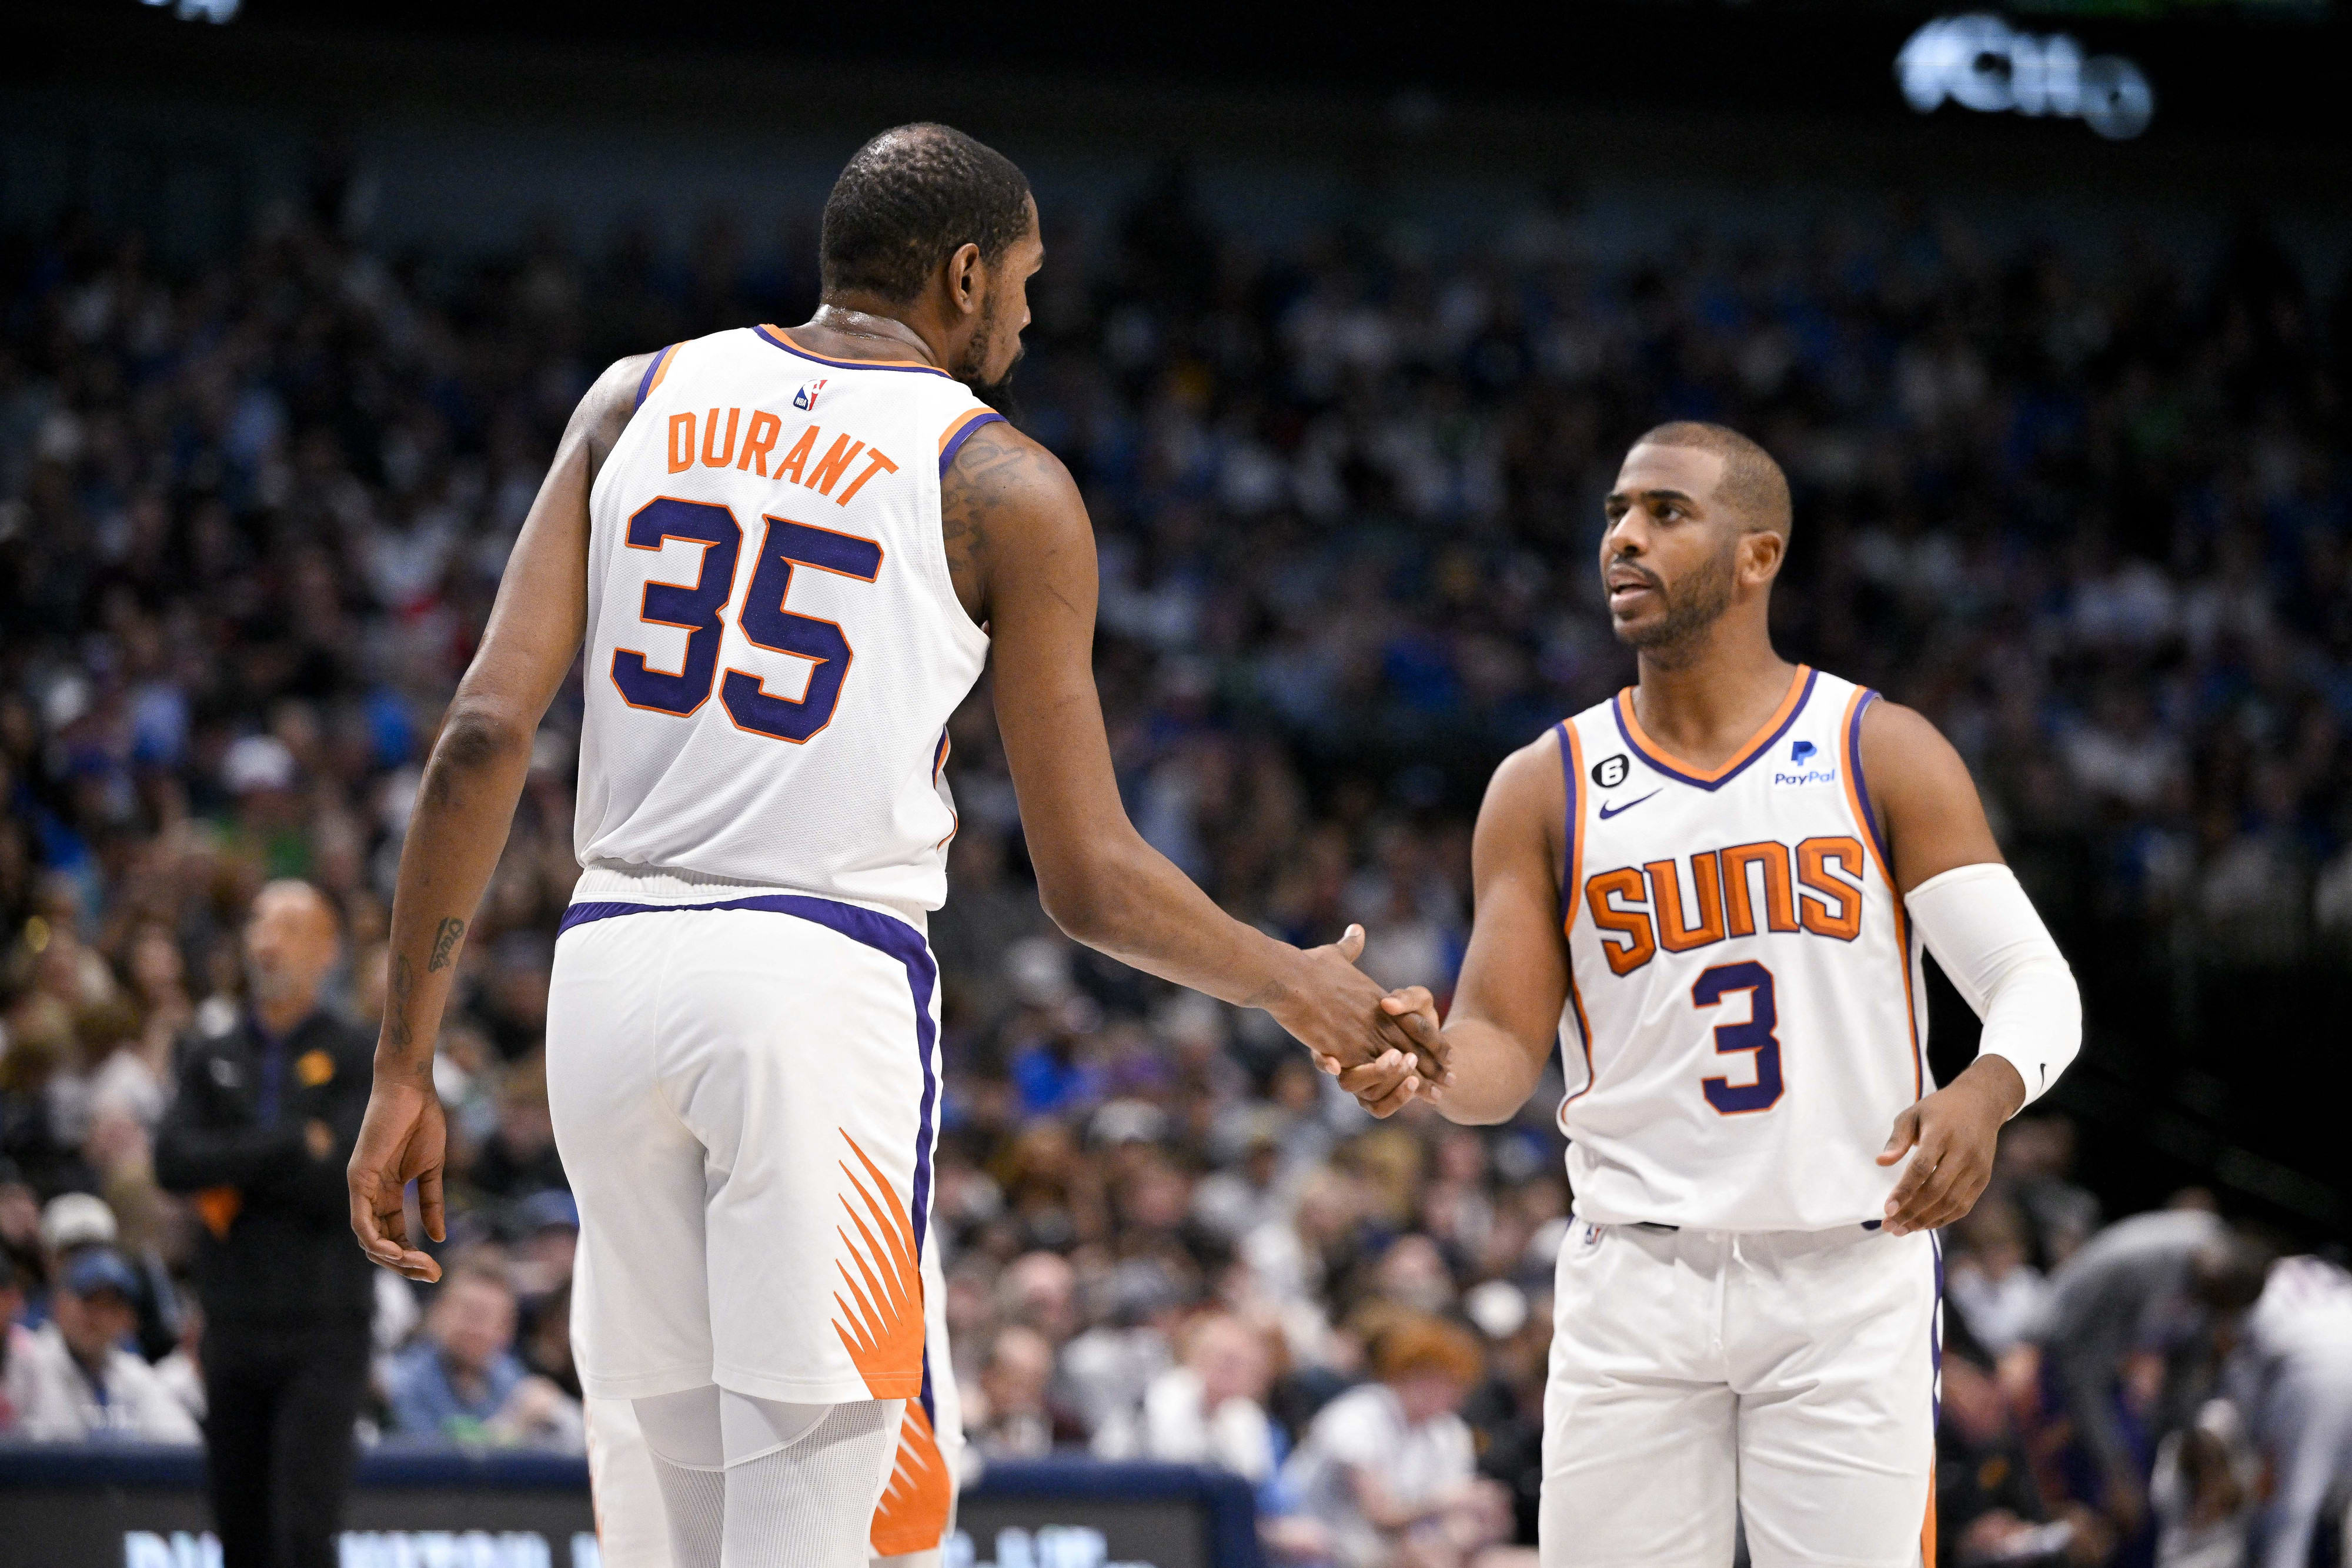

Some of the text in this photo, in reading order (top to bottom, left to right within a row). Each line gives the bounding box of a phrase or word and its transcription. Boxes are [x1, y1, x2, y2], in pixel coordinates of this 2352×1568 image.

[795, 397, 807, 407] NBA
[667, 407, 899, 507] DURANT
[610, 496, 884, 744] 35
[1601, 757, 1623, 786] 6
[1775, 769, 1835, 785] PayPal
[1585, 836, 1864, 977] SUNS
[1691, 959, 1784, 1115] 3
